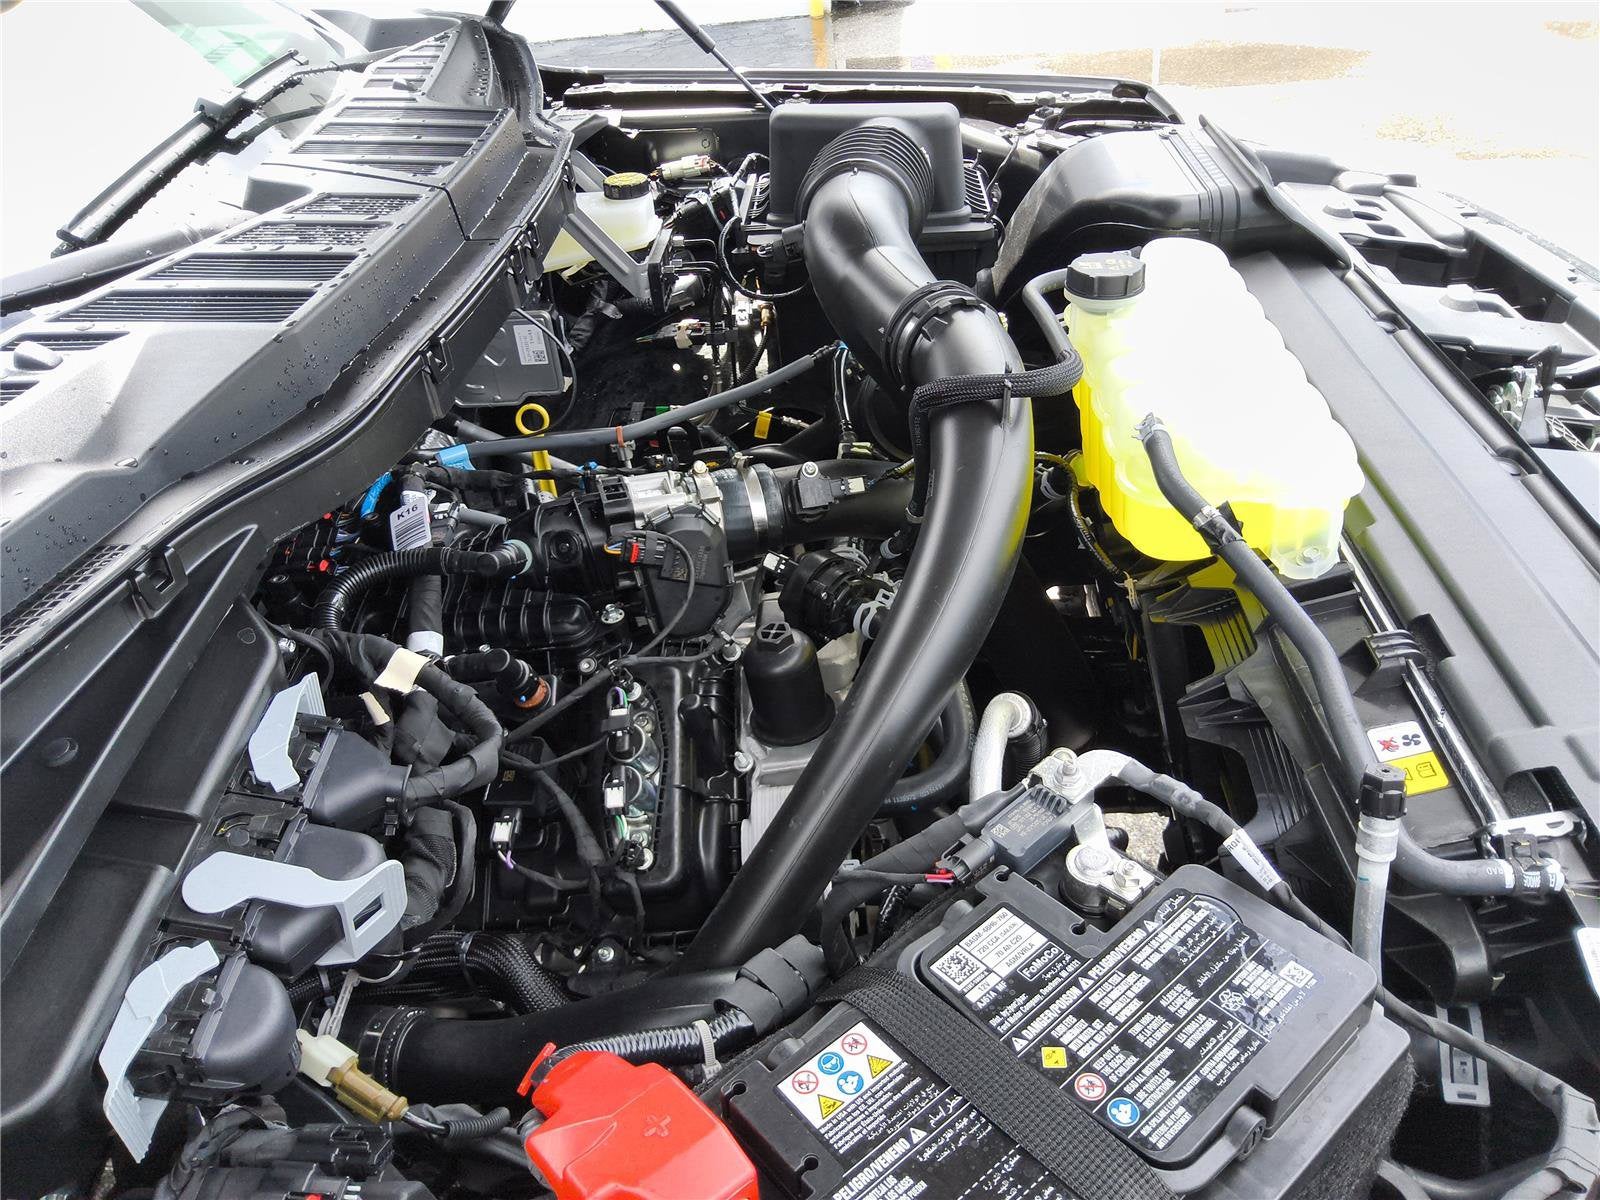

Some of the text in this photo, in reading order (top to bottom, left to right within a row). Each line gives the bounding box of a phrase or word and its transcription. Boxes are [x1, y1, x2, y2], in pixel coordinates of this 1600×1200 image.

[396, 504, 418, 521] K16
[1004, 941, 1035, 967] AGM/VRLA
[1021, 945, 1060, 977] FoMoCo
[1087, 927, 1148, 980] PELIGRO/VENENO
[975, 990, 997, 1007] AJ61A
[1020, 992, 1044, 1013] Company,
[1020, 984, 1083, 1039] DANGER/POISON
[869, 1075, 891, 1093] imported
[887, 1060, 908, 1078] materials
[1142, 1075, 1162, 1093] TOUTES
[824, 1118, 848, 1139] Fabricado
[881, 1072, 905, 1092] materiales
[833, 1131, 855, 1150] Fabriqué
[832, 1136, 912, 1200] PELIGRO/VENENO
[893, 1175, 914, 1194] GASES
